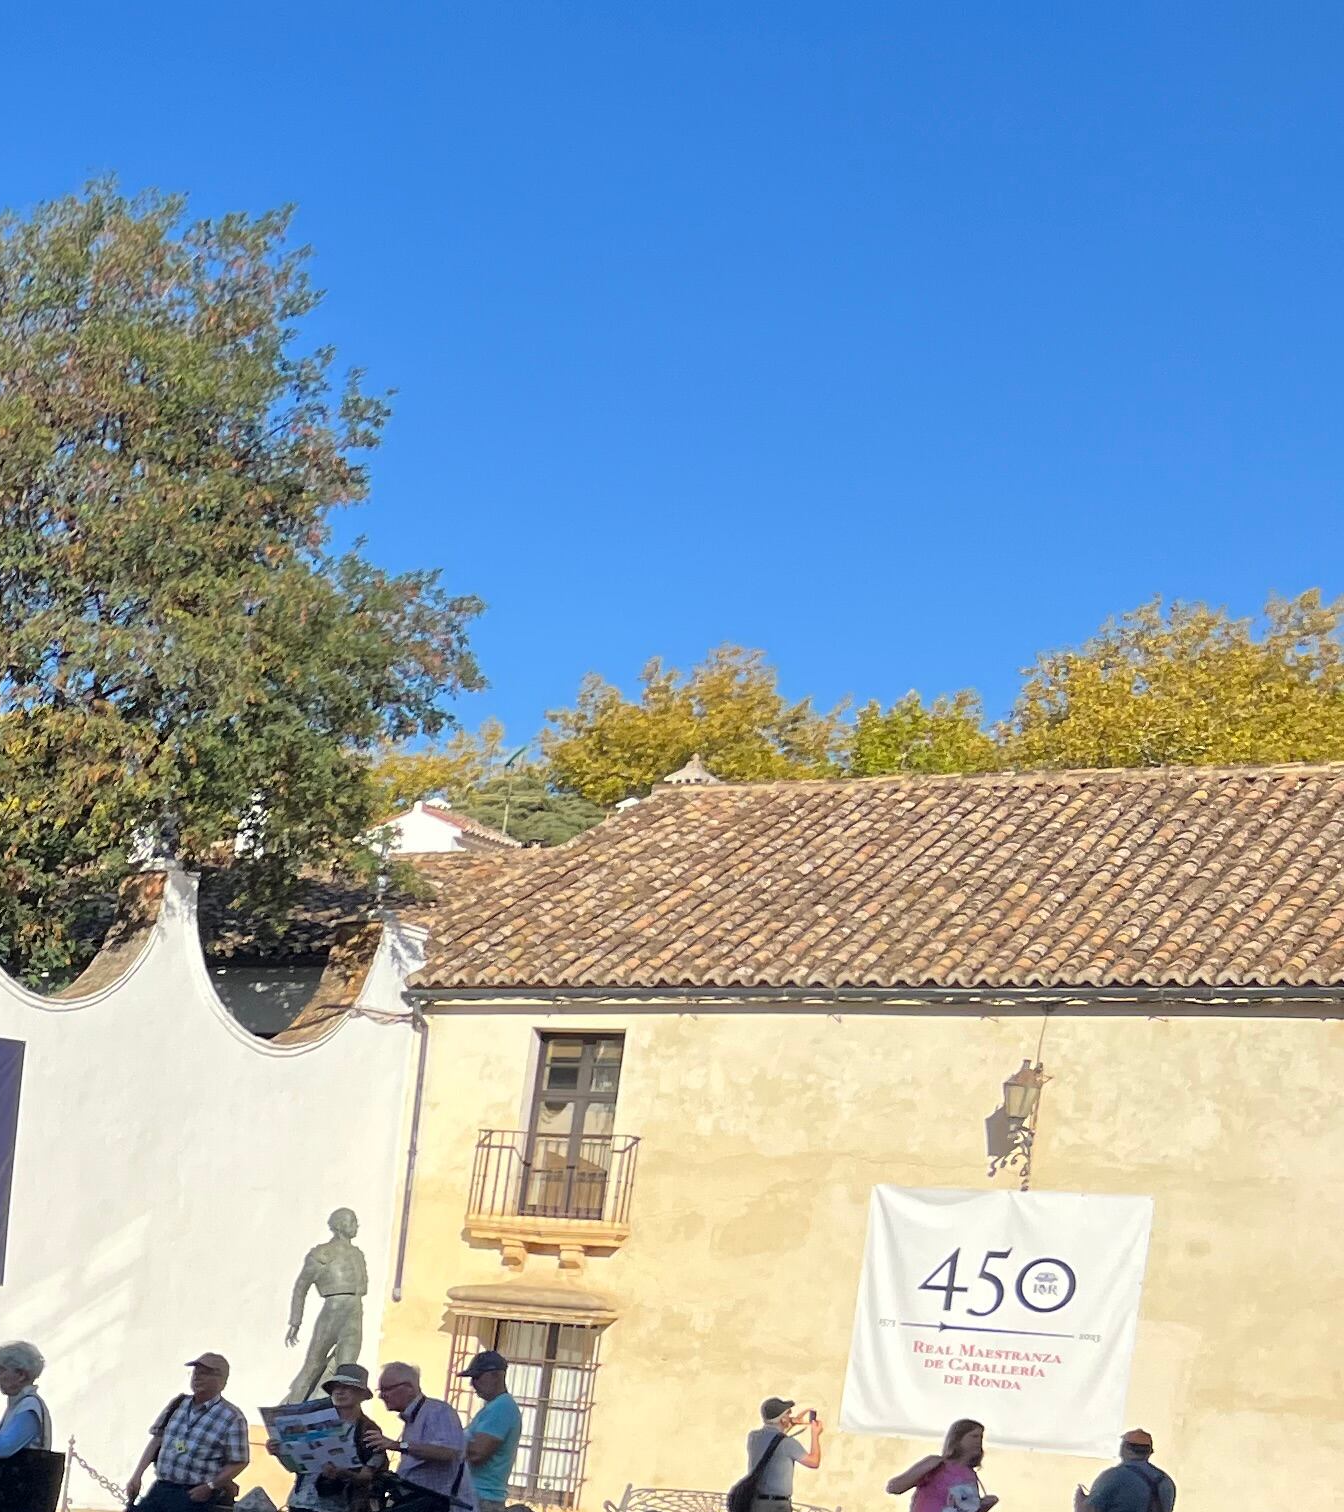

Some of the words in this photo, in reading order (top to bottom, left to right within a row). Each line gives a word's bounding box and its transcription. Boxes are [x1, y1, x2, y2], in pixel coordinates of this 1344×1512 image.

[918, 1247, 1077, 1317] 450
[913, 1340, 954, 1356] REAL
[960, 1344, 1062, 1364] MAESTRANZA
[924, 1358, 944, 1369] DE
[948, 1358, 1045, 1378] CABALLERÍA
[943, 1374, 963, 1385] DE
[968, 1373, 1022, 1391] RONDA
